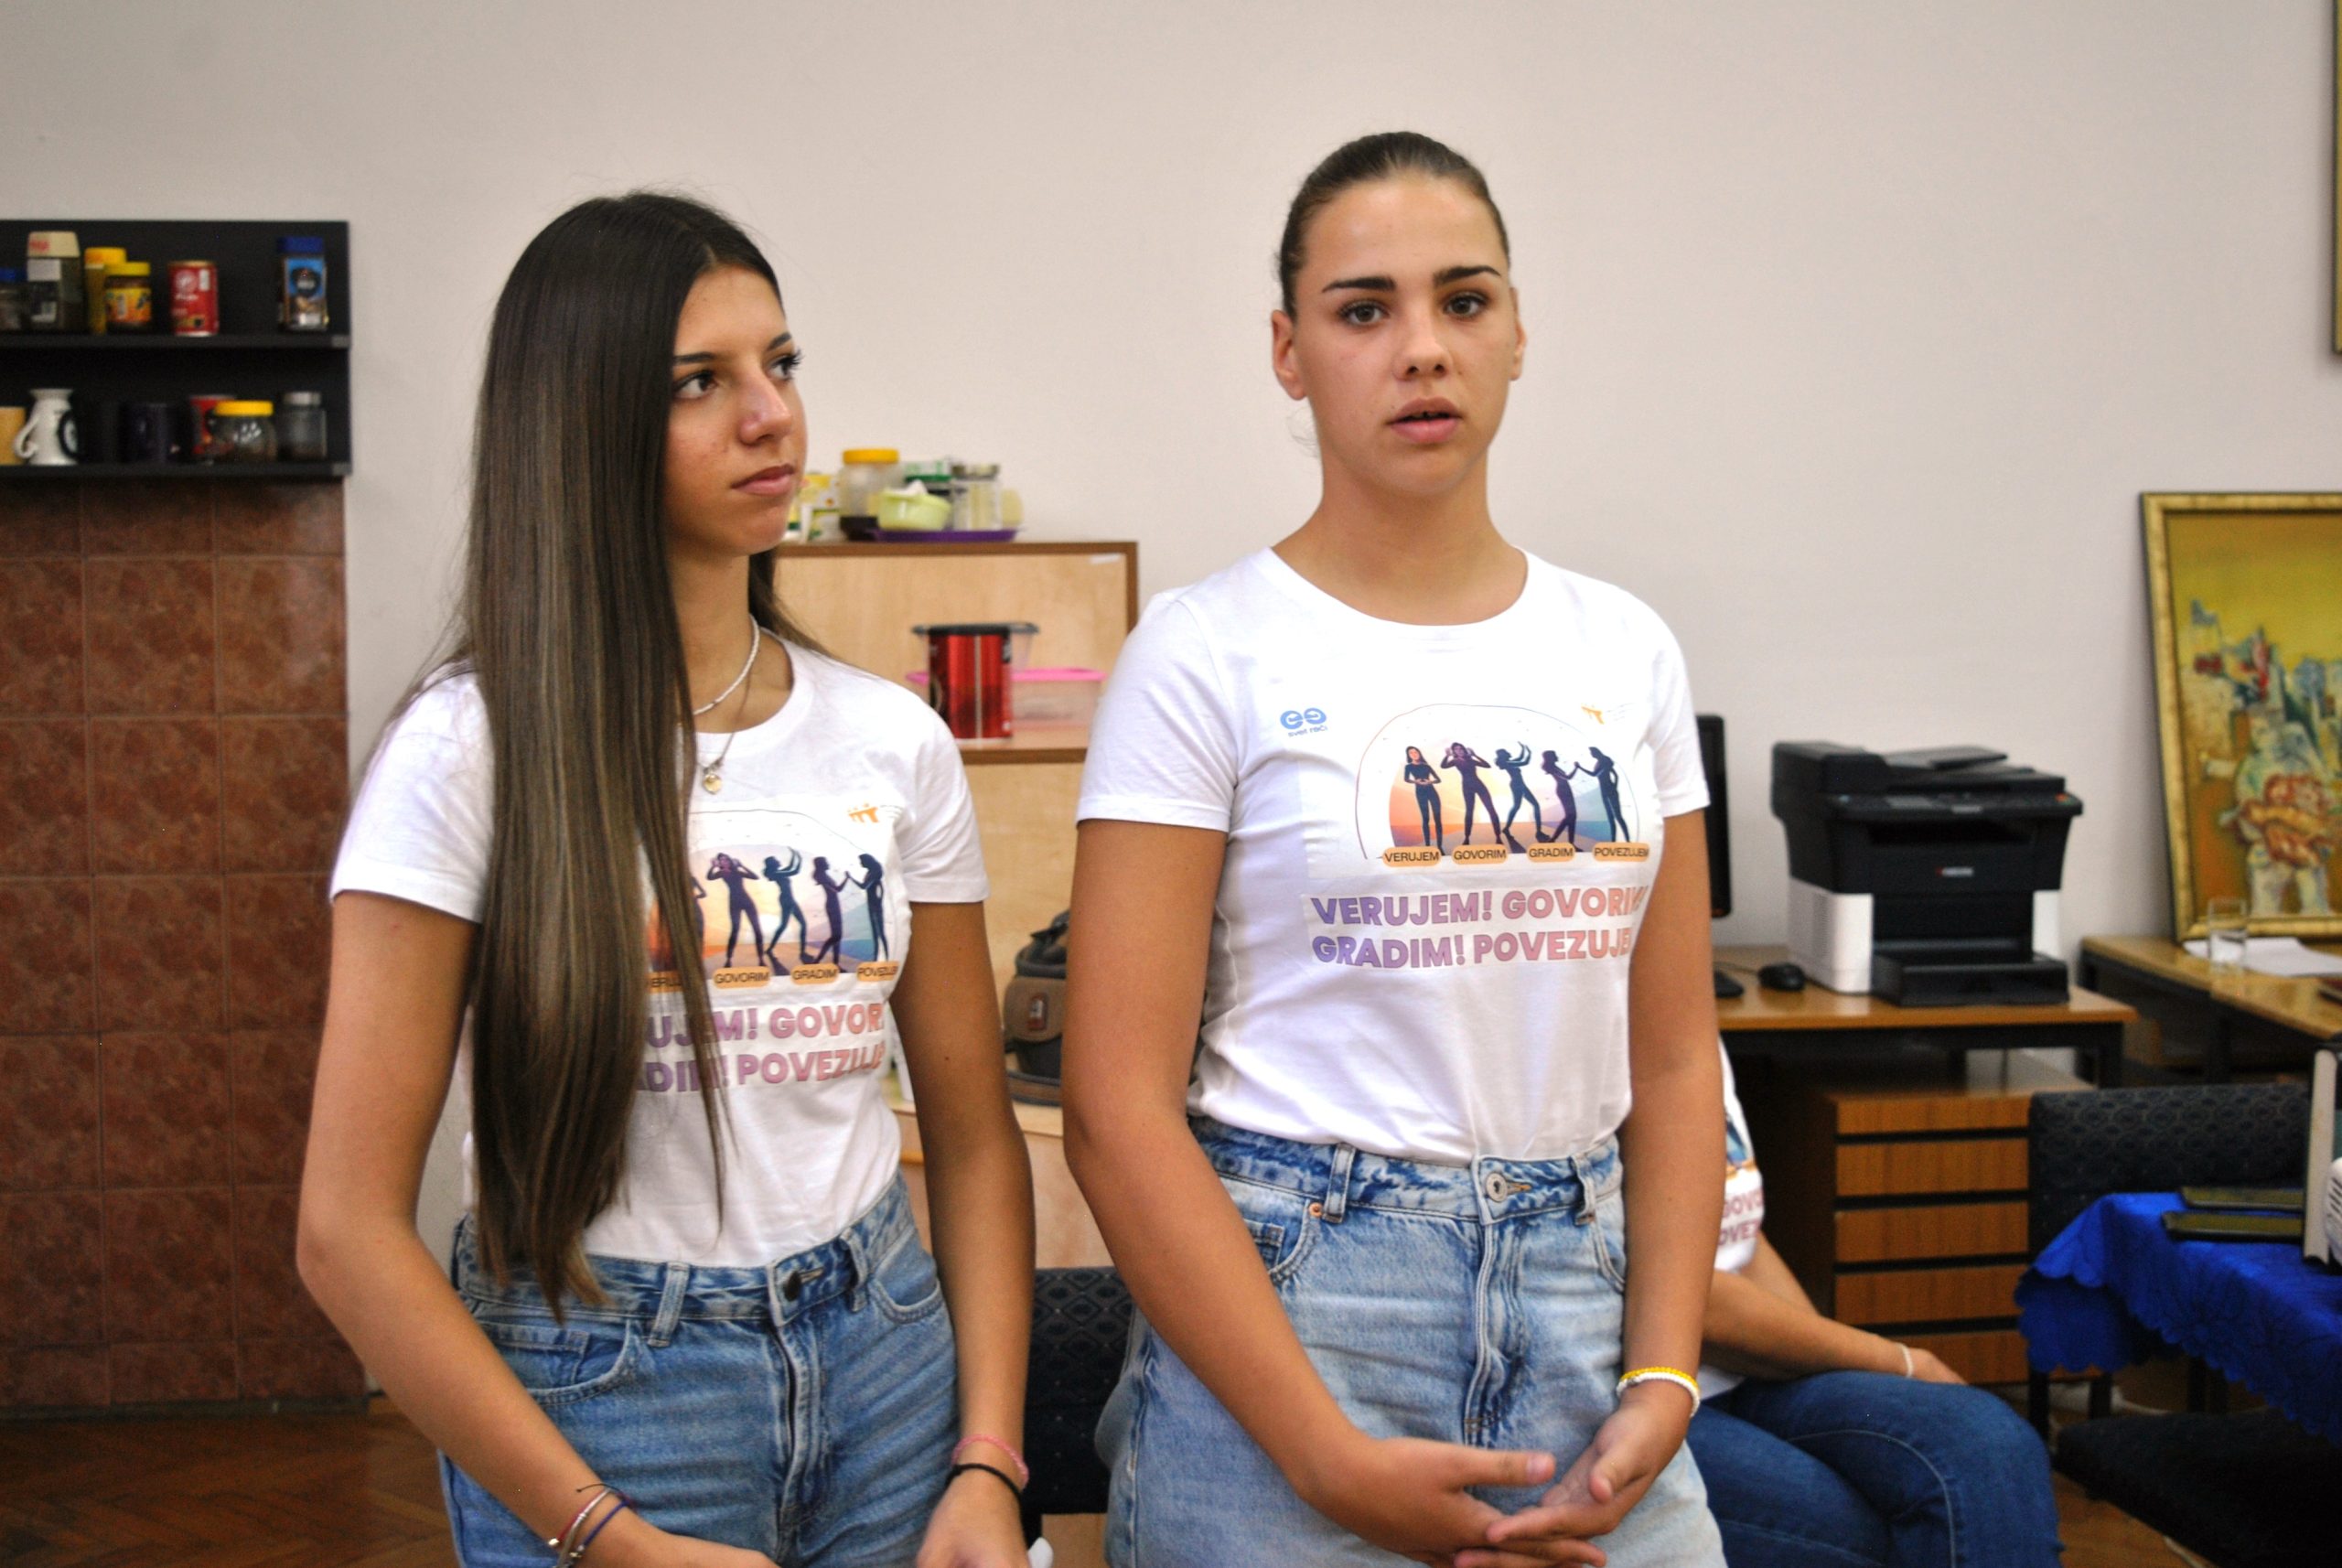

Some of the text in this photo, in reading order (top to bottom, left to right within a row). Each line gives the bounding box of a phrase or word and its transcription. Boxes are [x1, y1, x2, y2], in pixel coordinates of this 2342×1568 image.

[1384, 851, 1440, 863] VERUJEM
[1453, 849, 1507, 861] GOVORIM
[1529, 847, 1574, 858] GRADIM
[1310, 890, 1493, 926] VERUJEM!
[1311, 927, 1632, 969] GRADIM! POVEZUJE
[714, 972, 770, 984] GOVORIM
[791, 969, 838, 981] GRADIM
[769, 1003, 885, 1039] GOVOR
